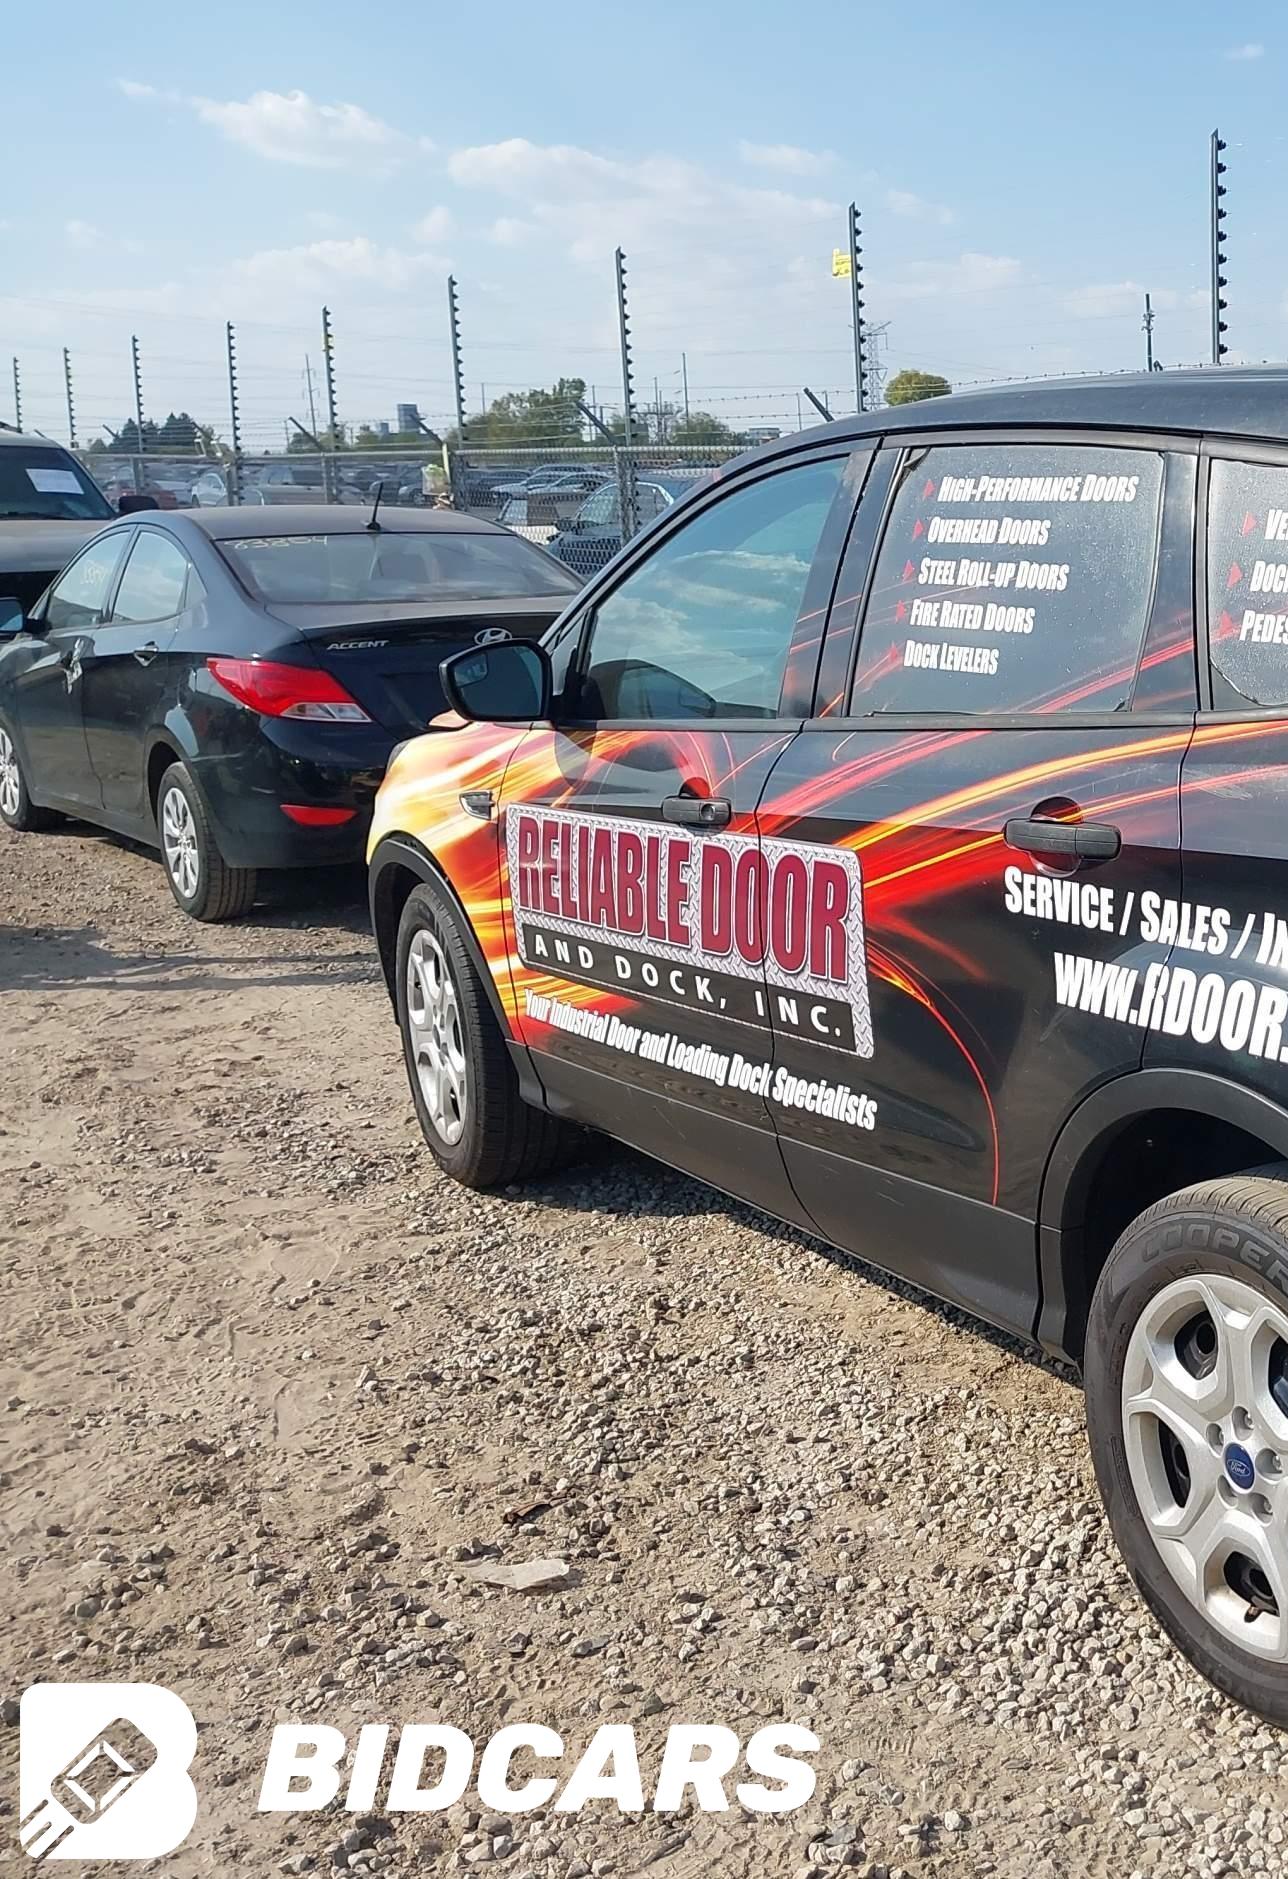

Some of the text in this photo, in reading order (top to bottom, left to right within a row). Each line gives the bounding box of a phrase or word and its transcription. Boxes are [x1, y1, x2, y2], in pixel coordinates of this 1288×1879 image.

[937, 474, 1139, 502] HIGH-PERFORMANCE DOORS
[928, 516, 1051, 545] OVERHEAD DOORS
[918, 557, 1070, 591] STEEL ROLL-UP DOORS
[910, 599, 1036, 634] FIRE RATED DOORS
[326, 640, 390, 650] ACCENT
[904, 640, 1000, 675] DOCK LEVELERS
[517, 815, 852, 984] RELIABLE DOOR
[1003, 865, 1115, 937] SERVICE
[1119, 891, 1135, 936] /
[1140, 889, 1232, 956] SALES
[1230, 912, 1256, 960] /
[535, 934, 842, 1037] AND DOCK, INC.
[524, 988, 551, 1022] Your
[605, 1015, 642, 1054] Door
[638, 1031, 671, 1064] and
[667, 1033, 730, 1087] Loading
[728, 1053, 773, 1098] Dock
[772, 1066, 878, 1131] Specialists
